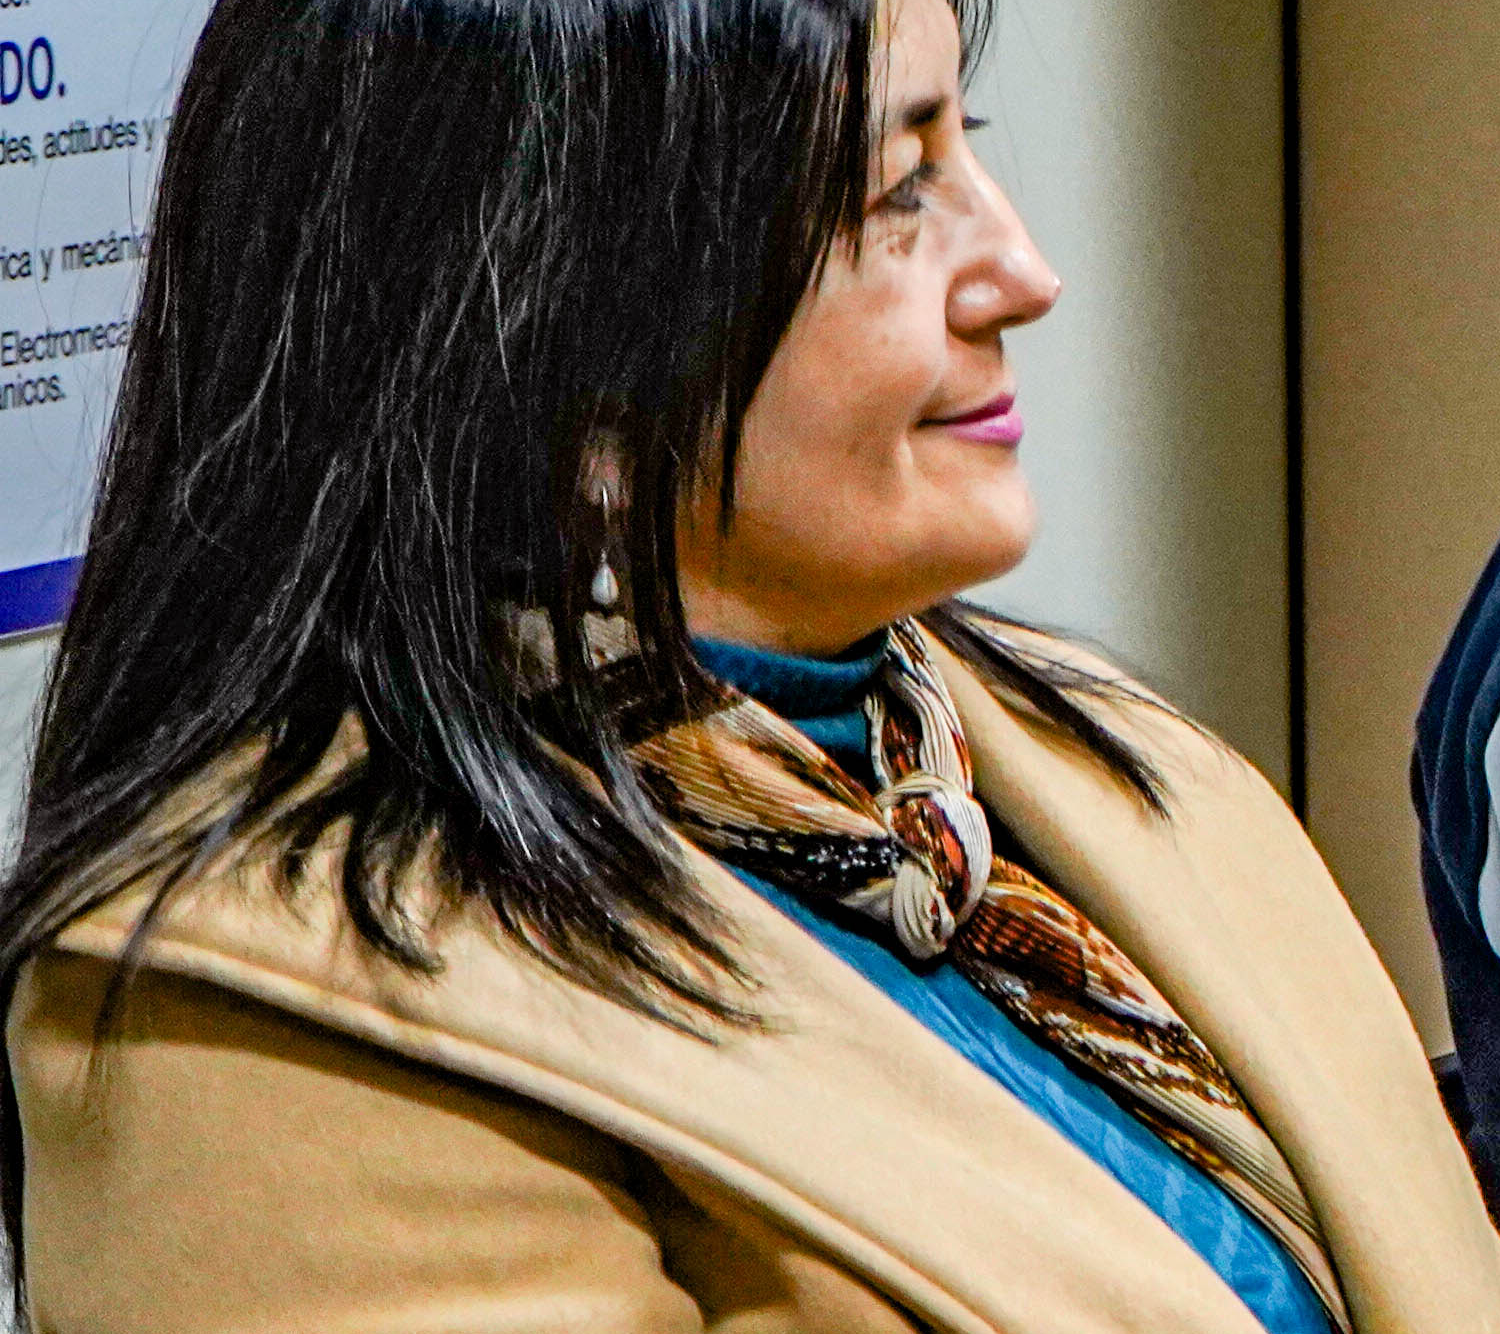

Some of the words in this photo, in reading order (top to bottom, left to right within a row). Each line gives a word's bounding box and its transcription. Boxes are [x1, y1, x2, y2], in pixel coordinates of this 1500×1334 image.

[44, 116, 139, 159] actitudes
[142, 117, 154, 152] y
[40, 247, 54, 283] y
[0, 373, 65, 411] nicos.
